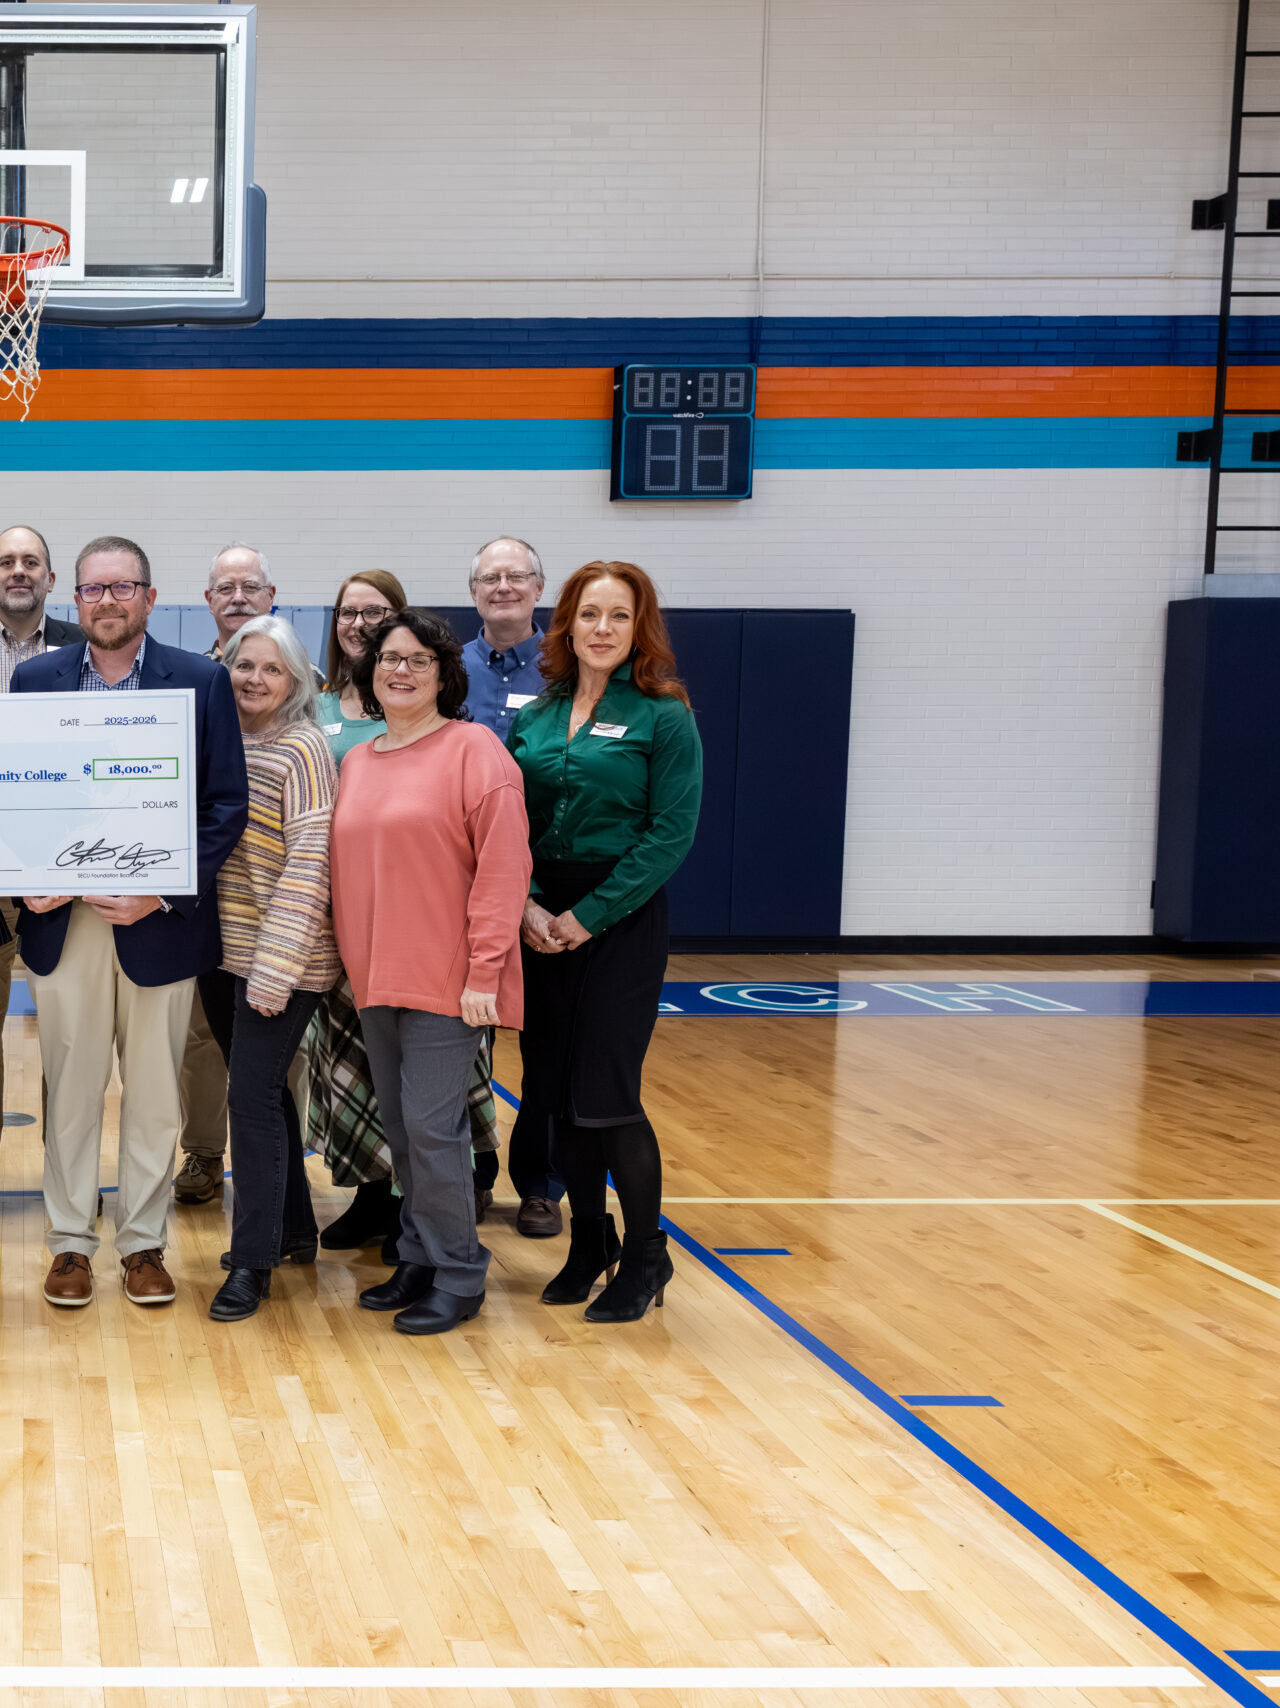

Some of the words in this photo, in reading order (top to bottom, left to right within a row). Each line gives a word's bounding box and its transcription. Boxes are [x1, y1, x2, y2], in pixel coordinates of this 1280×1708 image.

[60, 719, 80, 727] DATE
[104, 715, 157, 726] 2025-2026
[83, 763, 92, 776] $
[24, 770, 68, 782] College
[142, 801, 178, 809] DOLLARS
